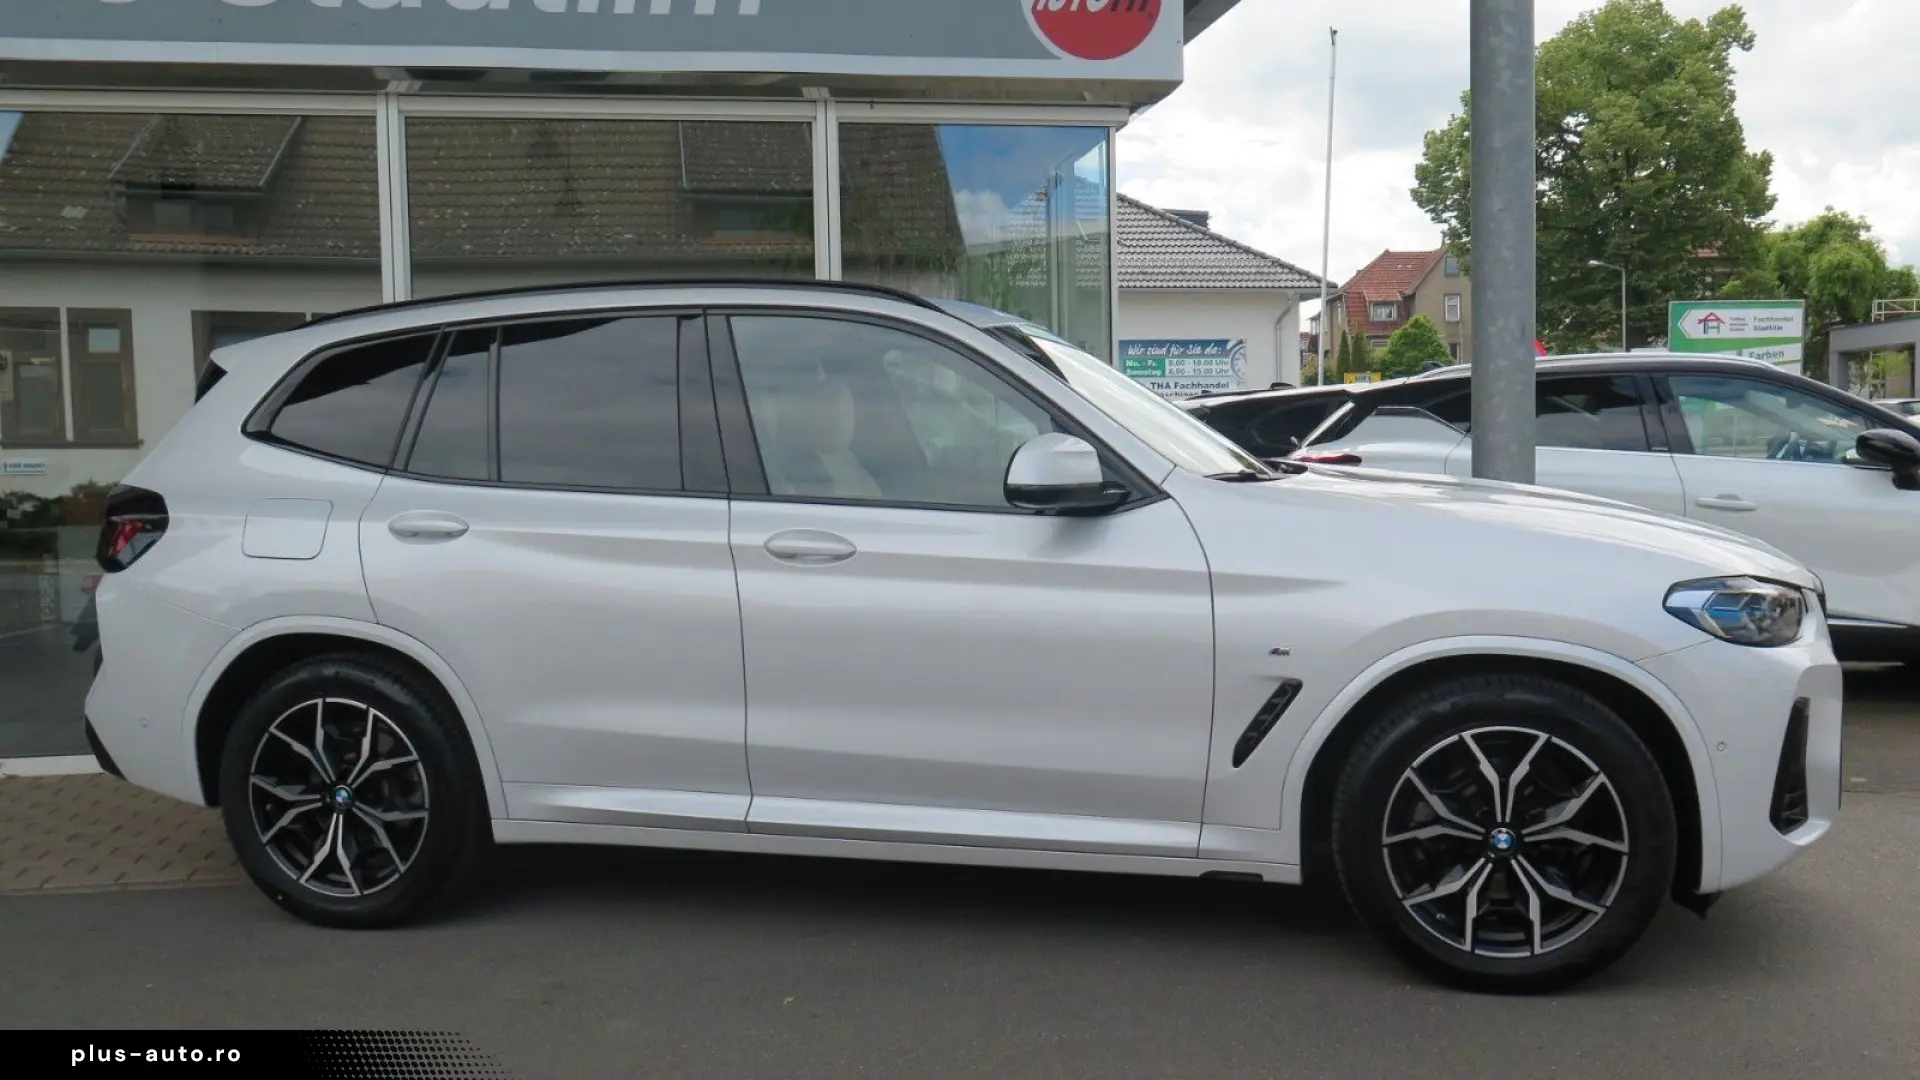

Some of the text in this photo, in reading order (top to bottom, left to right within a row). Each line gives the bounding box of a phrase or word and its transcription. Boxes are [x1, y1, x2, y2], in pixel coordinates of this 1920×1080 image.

[1127, 344, 1145, 355] Wir
[1147, 343, 1169, 355] sind
[1186, 344, 1202, 355] Sie
[1174, 381, 1230, 389] Fachhandel
